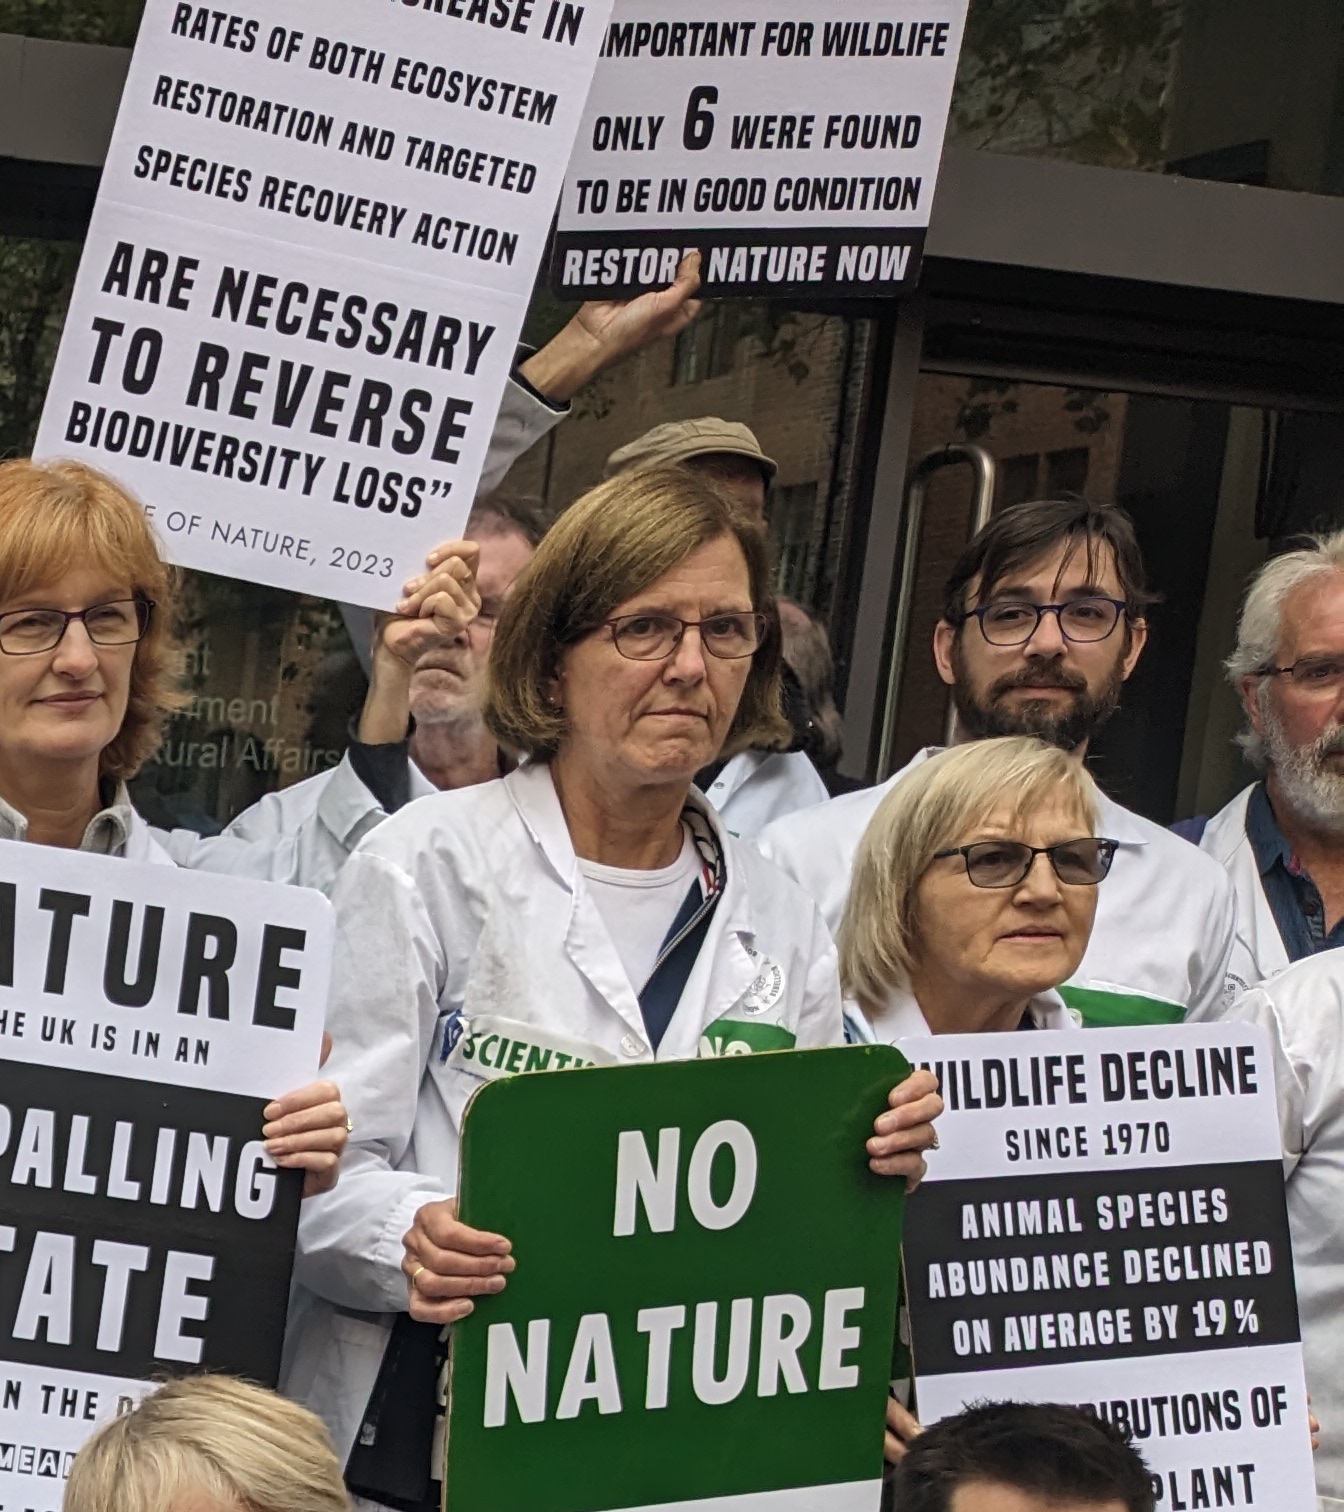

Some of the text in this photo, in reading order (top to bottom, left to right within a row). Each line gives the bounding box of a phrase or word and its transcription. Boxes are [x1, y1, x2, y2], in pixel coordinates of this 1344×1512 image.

[171, 2, 558, 126] RATES OF BOTH ECOSYSTEM
[152, 74, 536, 195] RESTORATION AND TARGETED
[592, 85, 922, 151] ONLY 6 WERE FOUND
[134, 146, 519, 266] SPECIES RECOVERY ACTION
[576, 177, 922, 214] TO BE IN GOOD CONDITION
[101, 242, 496, 376] ARE NECESSARY
[88, 317, 474, 464] TO REVERSE
[65, 401, 325, 496] BIODIVERSITY
[166, 510, 201, 534] OF
[212, 520, 316, 565] NATURE,
[329, 546, 394, 579] 2023
[240, 737, 341, 772] Affairs
[40, 1015, 74, 1045] UK
[91, 1023, 116, 1051] IS
[133, 1030, 160, 1057] IN
[175, 1037, 211, 1066] AN
[1102, 1045, 1258, 1103] DECLINE
[1006, 1121, 1170, 1162] SINCE 1970
[613, 1119, 757, 1237] NO
[962, 1188, 1228, 1240] ANIMAL SPECIES
[928, 1241, 1271, 1299] ABUNDANCE DECLINED
[483, 1287, 865, 1428] NATURE
[953, 1318, 992, 1355] ON
[1005, 1306, 1133, 1351] AVERAGE
[1144, 1307, 1178, 1343] BY
